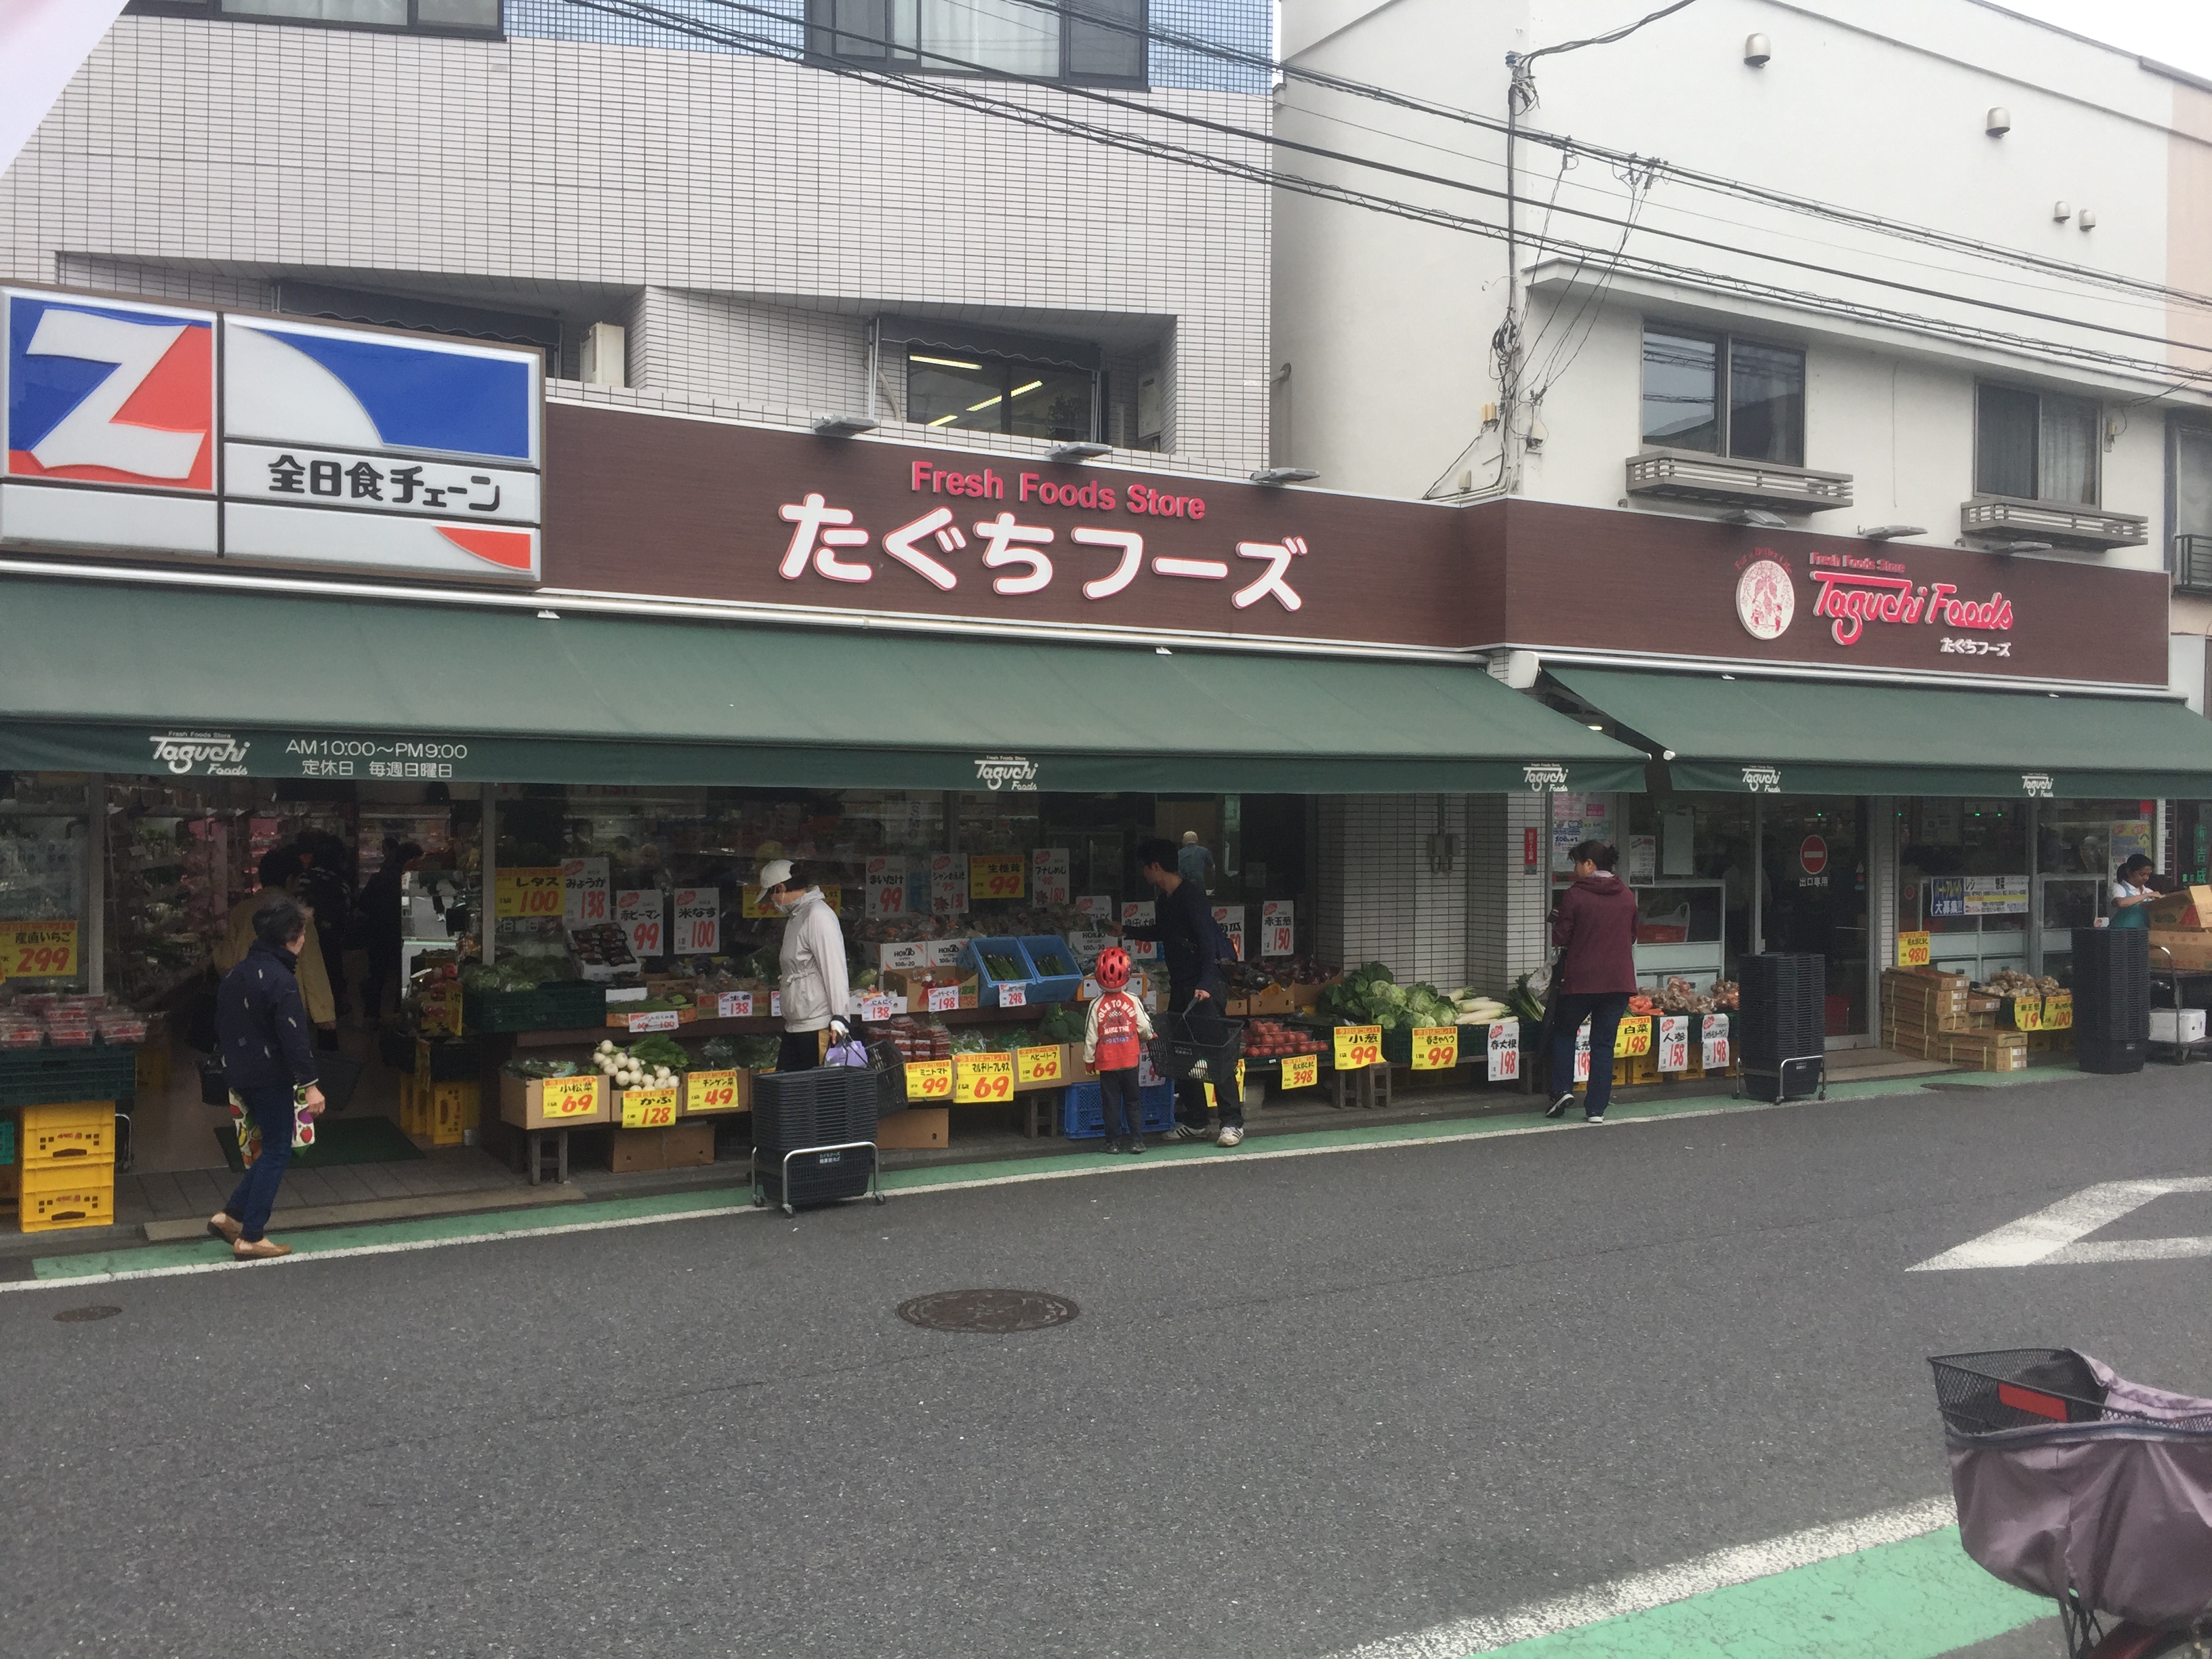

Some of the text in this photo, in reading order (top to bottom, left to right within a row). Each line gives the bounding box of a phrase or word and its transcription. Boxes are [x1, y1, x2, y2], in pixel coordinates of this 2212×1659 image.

[268, 455, 501, 512] 全日食チェーン
[912, 461, 1206, 520] Fresh Foods Store
[778, 492, 1308, 612] たぐちフーズ
[1809, 552, 1906, 573] Fresh Foods Store
[1809, 571, 2014, 646] Taguchi Foods
[1940, 637, 2011, 657] たぐちフーズ
[148, 736, 251, 774] Taguchi
[207, 763, 249, 775] Foods
[302, 760, 453, 778] 定休日 毎週日曜日
[974, 760, 1039, 790] Taguchi
[1011, 781, 1038, 791] Foods
[1523, 766, 1569, 792] Taguchi
[1742, 768, 1782, 792] Taguchi
[2022, 775, 2054, 797] Taguchi
[988, 863, 1021, 873] 生椎茸
[516, 876, 559, 887] レタス
[869, 875, 903, 884] まいたけ
[989, 876, 1021, 895] 99
[1799, 876, 1828, 888] 出口専用
[520, 890, 558, 912] 100
[880, 887, 902, 912] 99
[1050, 887, 1065, 903] 180
[581, 890, 606, 919] 138
[678, 907, 716, 918] 米なす
[1265, 916, 1292, 926] 赤玉葱
[634, 922, 659, 949] 99
[691, 921, 714, 948] 100
[1273, 928, 1290, 950] 150
[16, 947, 70, 972] 299
[1908, 947, 1928, 962] 980
[939, 997, 956, 1009] 198
[1008, 993, 1023, 1004] 298
[1111, 1000, 1122, 1008] TO
[730, 1002, 749, 1015] 138
[872, 1006, 890, 1019] 138
[2053, 1010, 2071, 1027] 100
[1624, 1024, 1648, 1034] 白菜
[1349, 1033, 1378, 1044] 小葱
[1624, 1036, 1647, 1054] 198
[1351, 1045, 1378, 1065] 99
[1428, 1046, 1454, 1066] 99
[1669, 1044, 1685, 1067] 158
[1713, 1040, 1726, 1063] 198
[920, 1067, 948, 1076] ミニトマト
[972, 1062, 1010, 1073] マルチリーフレタス
[1033, 1061, 1057, 1078] 69
[1500, 1050, 1517, 1076] 198
[922, 1077, 948, 1093] 99
[1294, 1069, 1314, 1085] 398
[560, 1082, 594, 1093] 小松菜
[704, 1088, 734, 1105] 49
[974, 1076, 1010, 1099] 69
[561, 1094, 593, 1113] 69
[640, 1096, 672, 1106] かぶ
[642, 1107, 672, 1125] 128
